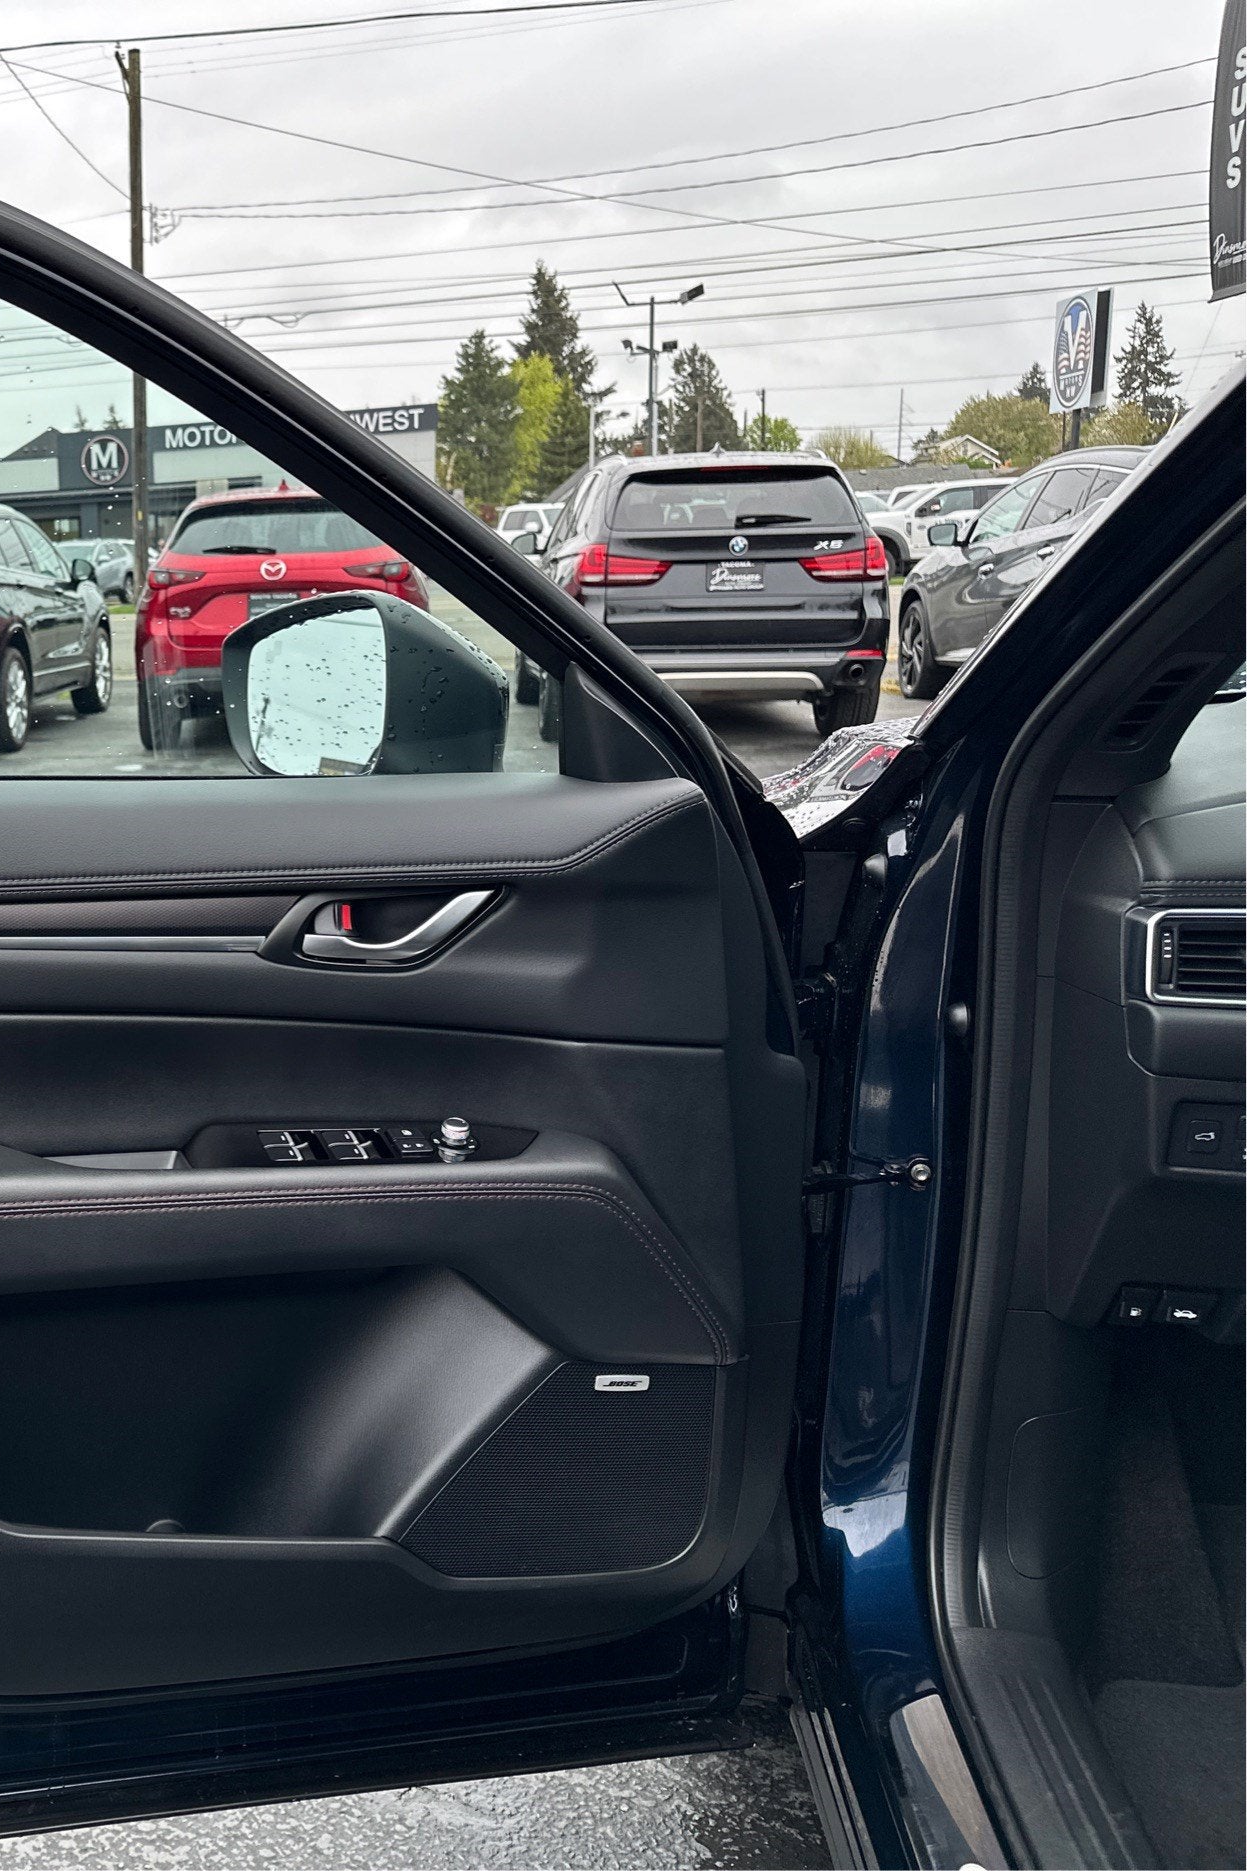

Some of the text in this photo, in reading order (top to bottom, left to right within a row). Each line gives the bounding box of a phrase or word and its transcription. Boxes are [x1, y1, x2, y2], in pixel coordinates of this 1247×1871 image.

[1226, 46, 1246, 189] SUVS
[350, 408, 424, 432] WEST
[90, 442, 118, 470] M
